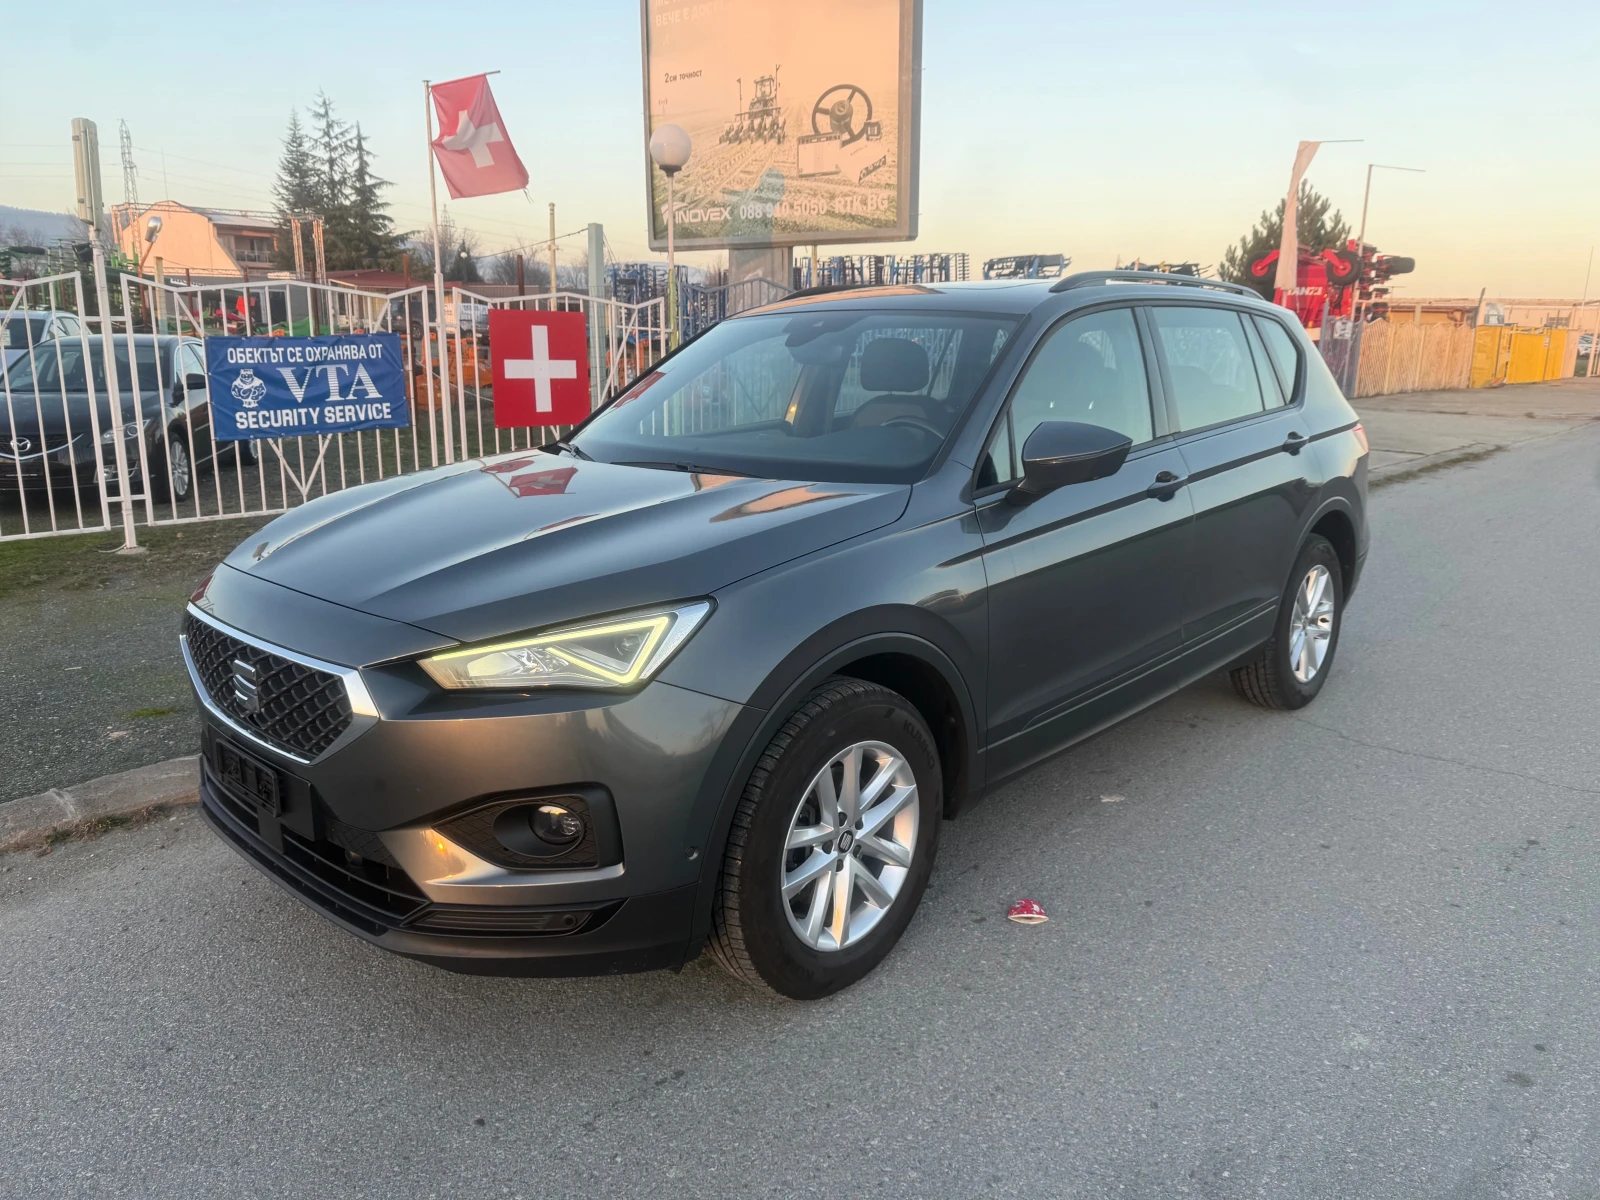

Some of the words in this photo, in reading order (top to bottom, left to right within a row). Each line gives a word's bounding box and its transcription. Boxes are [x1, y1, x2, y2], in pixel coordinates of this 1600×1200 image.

[656, 9, 681, 27] ВЕЧЕ
[739, 201, 763, 220] 088
[793, 198, 828, 215] 5050
[227, 347, 284, 364] ОБЕКТЪТ
[286, 347, 304, 363] СЕ
[305, 344, 367, 362] ОХРАНЯВА
[368, 344, 383, 359] ОТ
[276, 363, 383, 403] VTA
[235, 407, 320, 430] SECURITY
[324, 402, 392, 424] SERVICE
